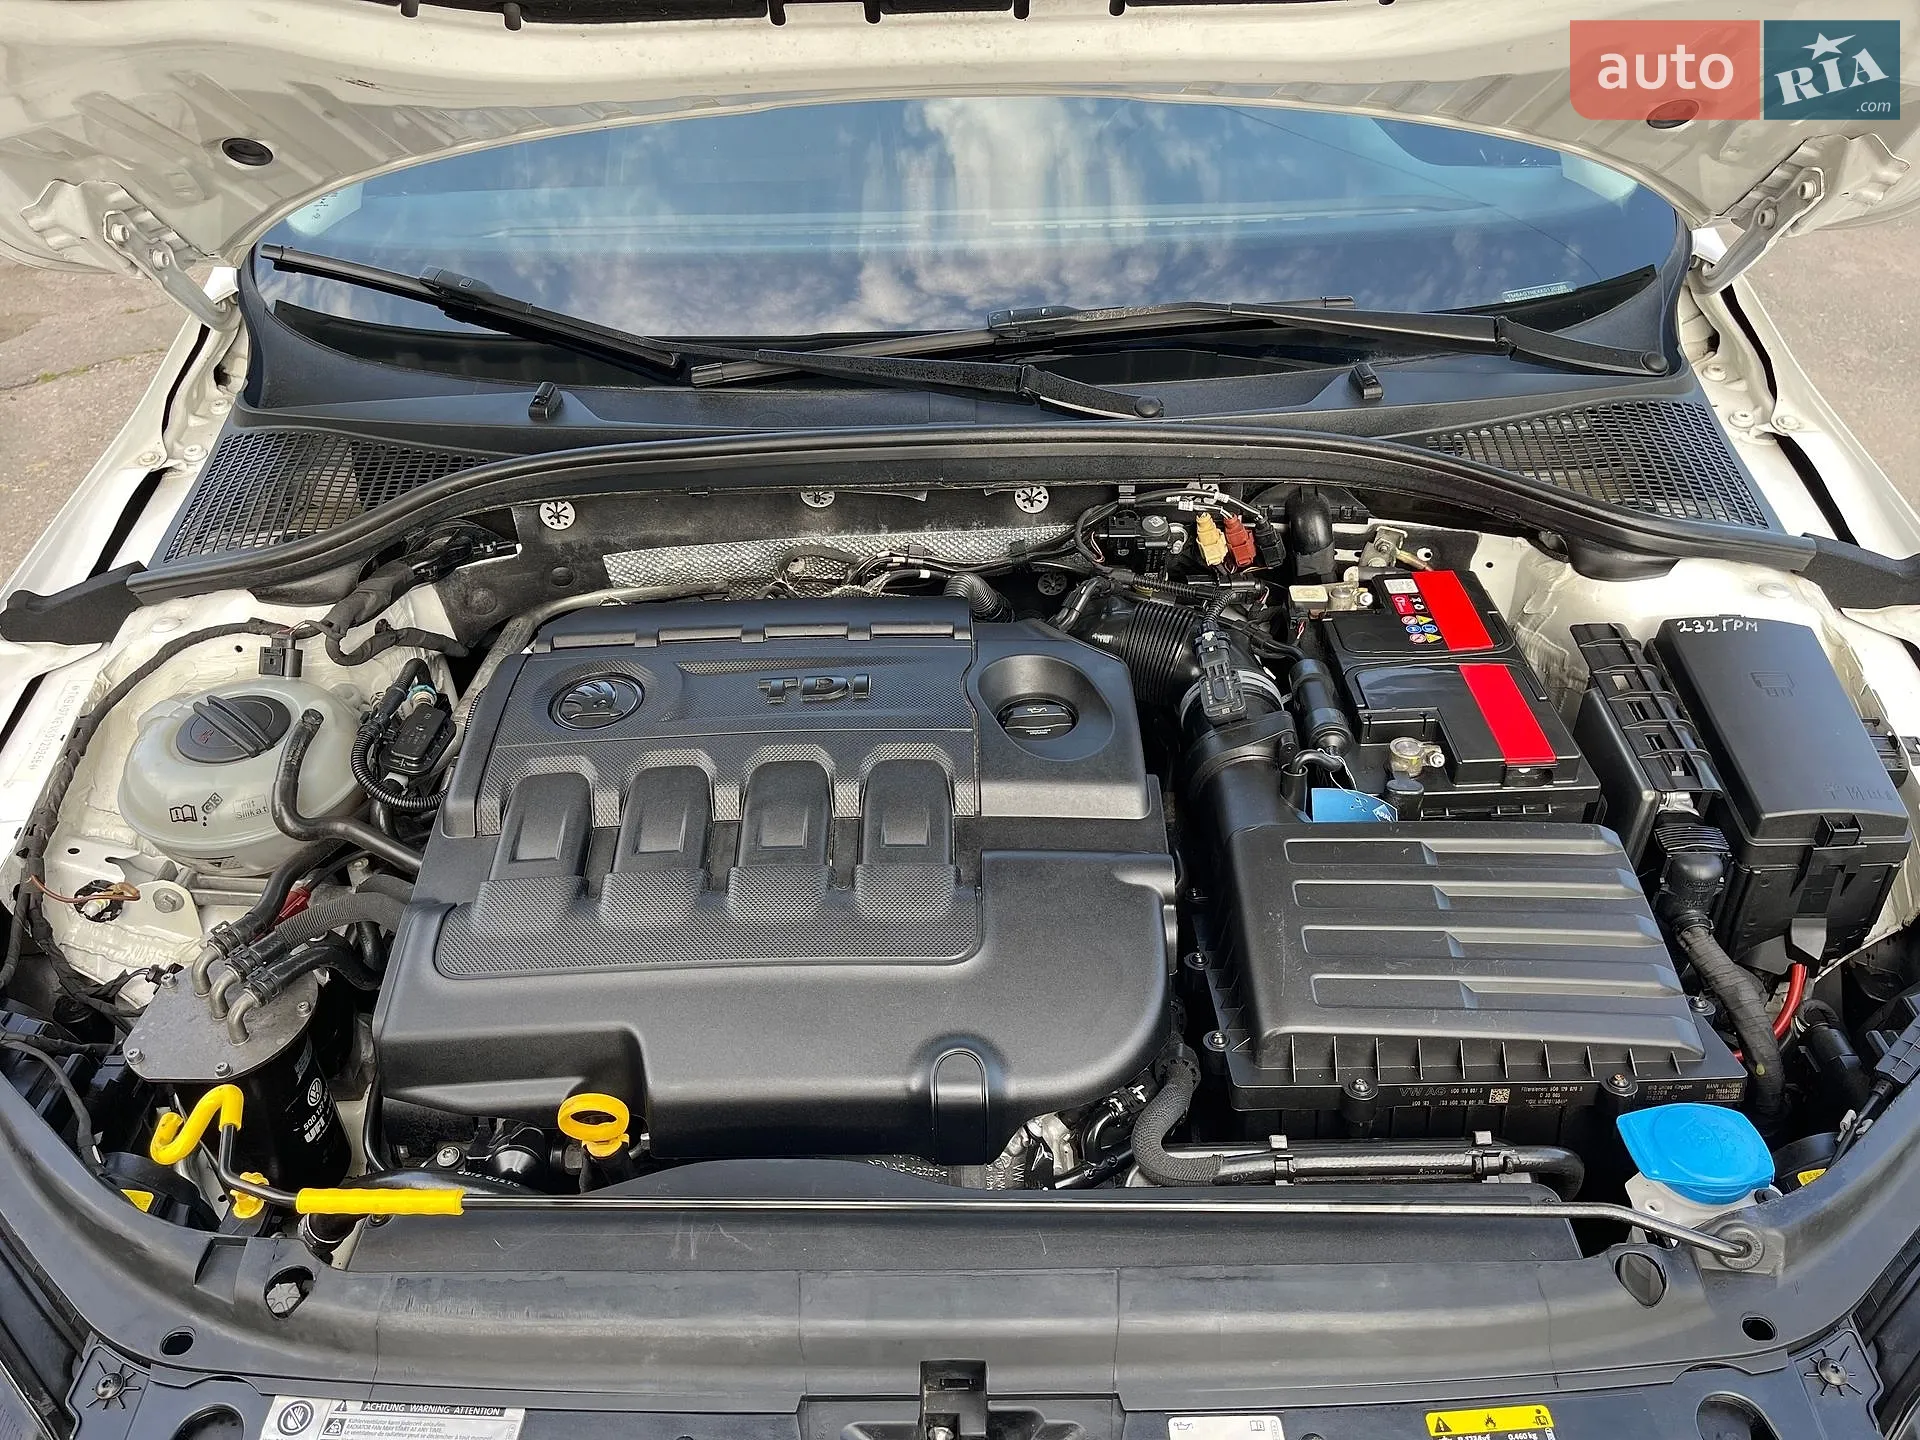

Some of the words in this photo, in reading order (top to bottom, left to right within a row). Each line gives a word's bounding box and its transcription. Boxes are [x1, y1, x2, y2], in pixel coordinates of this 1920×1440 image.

[757, 674, 872, 703] TDI
[1400, 1086, 1424, 1097] VW
[1425, 1086, 1447, 1097] AG
[364, 1402, 406, 1412] ACHTUNG
[410, 1404, 450, 1413] WARNING
[453, 1406, 500, 1415] ATTENTION
